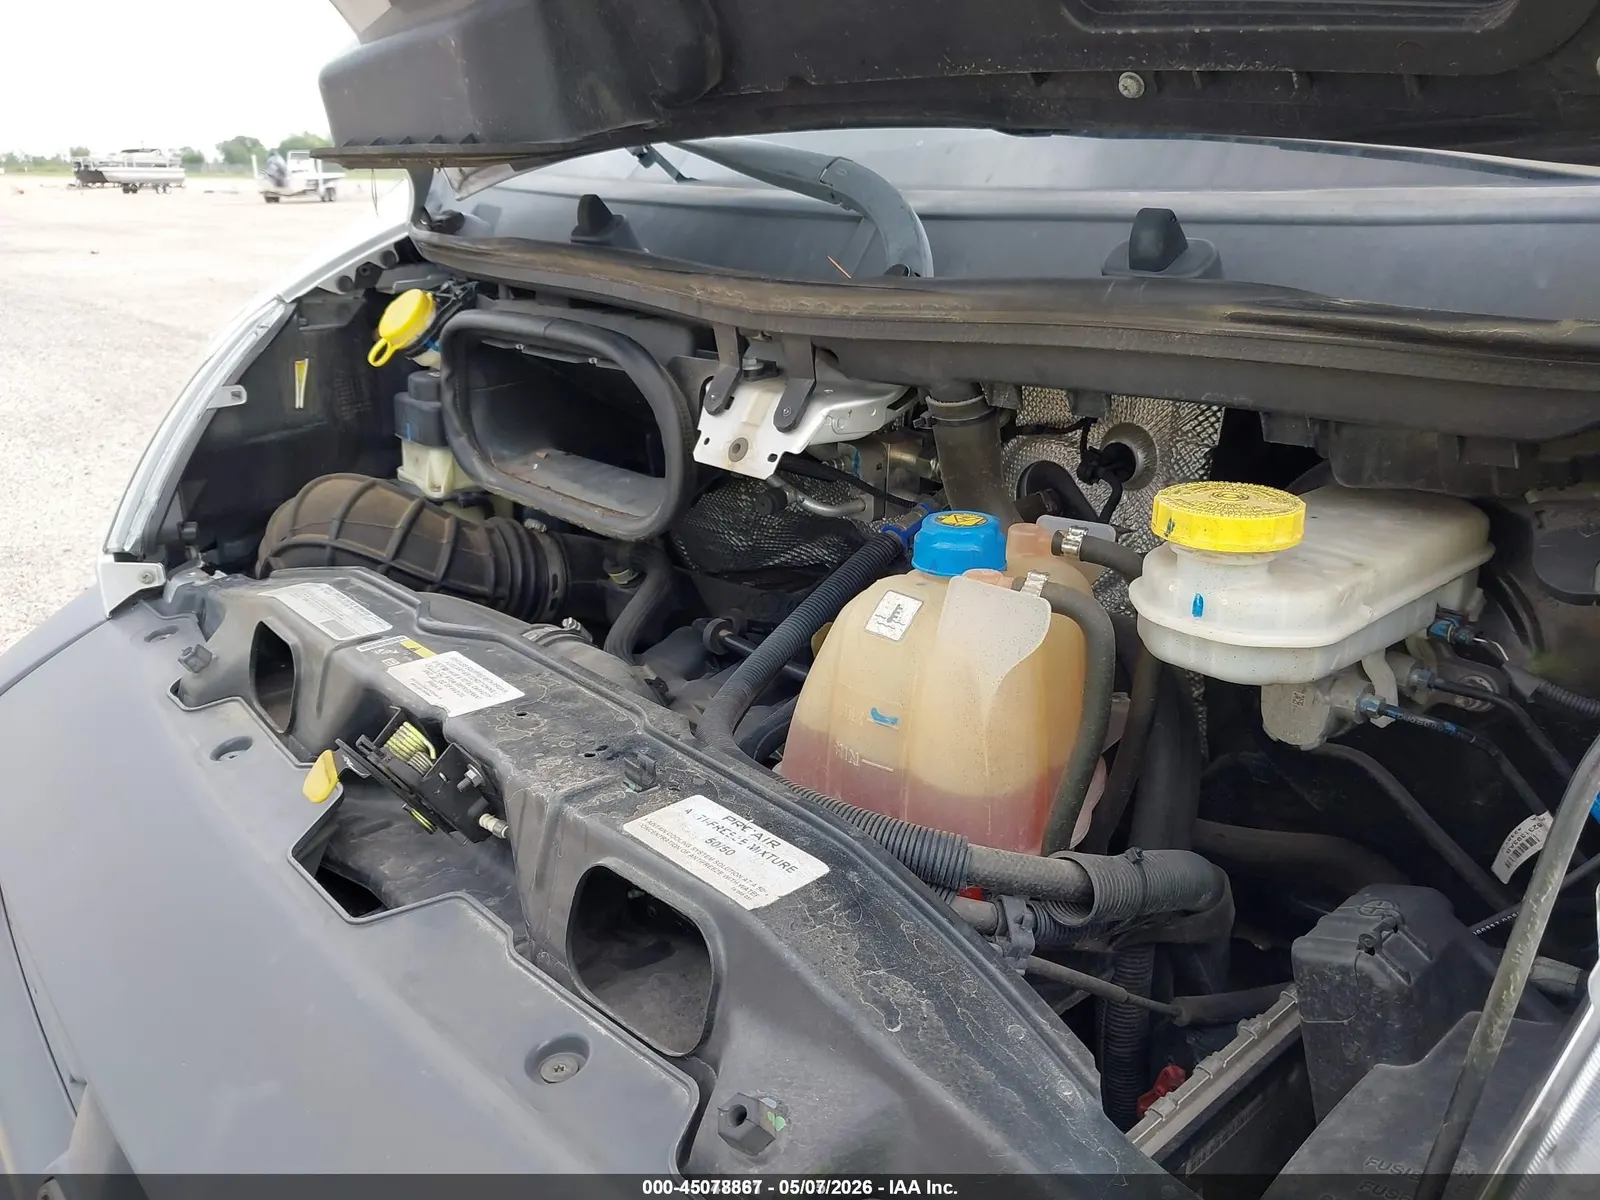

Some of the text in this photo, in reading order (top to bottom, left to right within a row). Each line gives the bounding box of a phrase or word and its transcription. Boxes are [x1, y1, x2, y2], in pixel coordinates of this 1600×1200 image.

[642, 818, 667, 833] AINTAIN
[666, 832, 692, 848] COOLING
[691, 847, 716, 861] SYSTEM
[713, 860, 744, 878] SOLUTION
[684, 808, 799, 873] ATI-FREEE MIXTURE
[704, 837, 736, 856] 50/50
